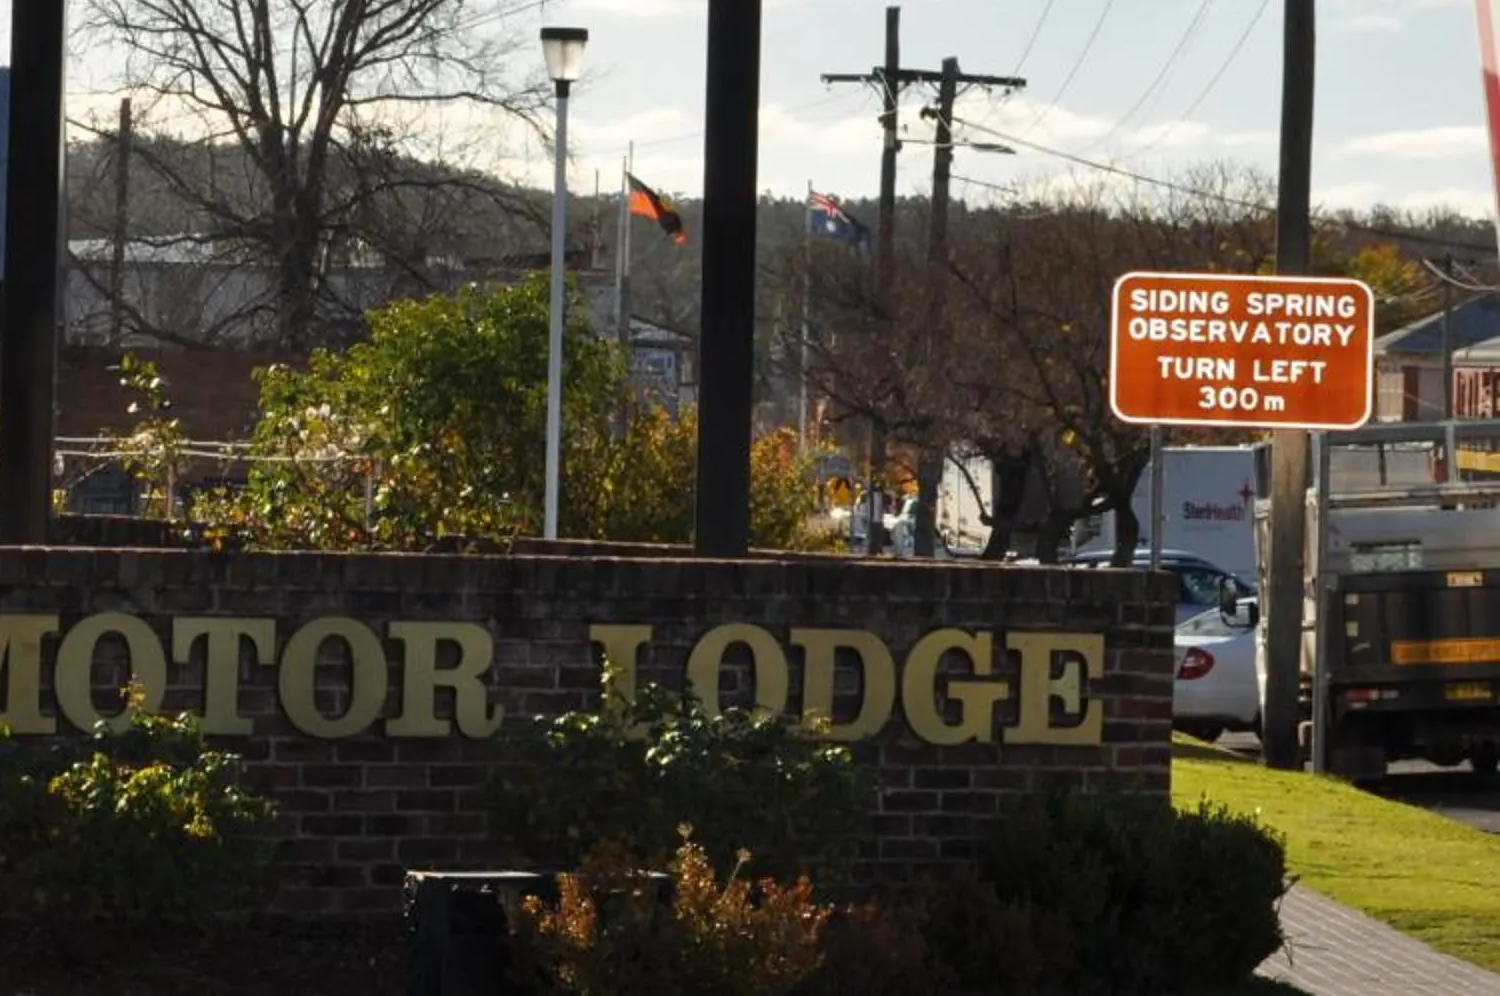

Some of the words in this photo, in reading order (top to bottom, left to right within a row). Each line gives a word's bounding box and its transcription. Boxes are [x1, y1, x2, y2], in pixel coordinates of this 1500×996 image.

[1130, 289, 1229, 315] SIDING
[1246, 292, 1357, 317] SPRING
[1128, 317, 1357, 348] OBSERVATORY
[1157, 356, 1236, 381] TURN
[1253, 359, 1327, 385] LEFT
[1199, 386, 1258, 411] 300
